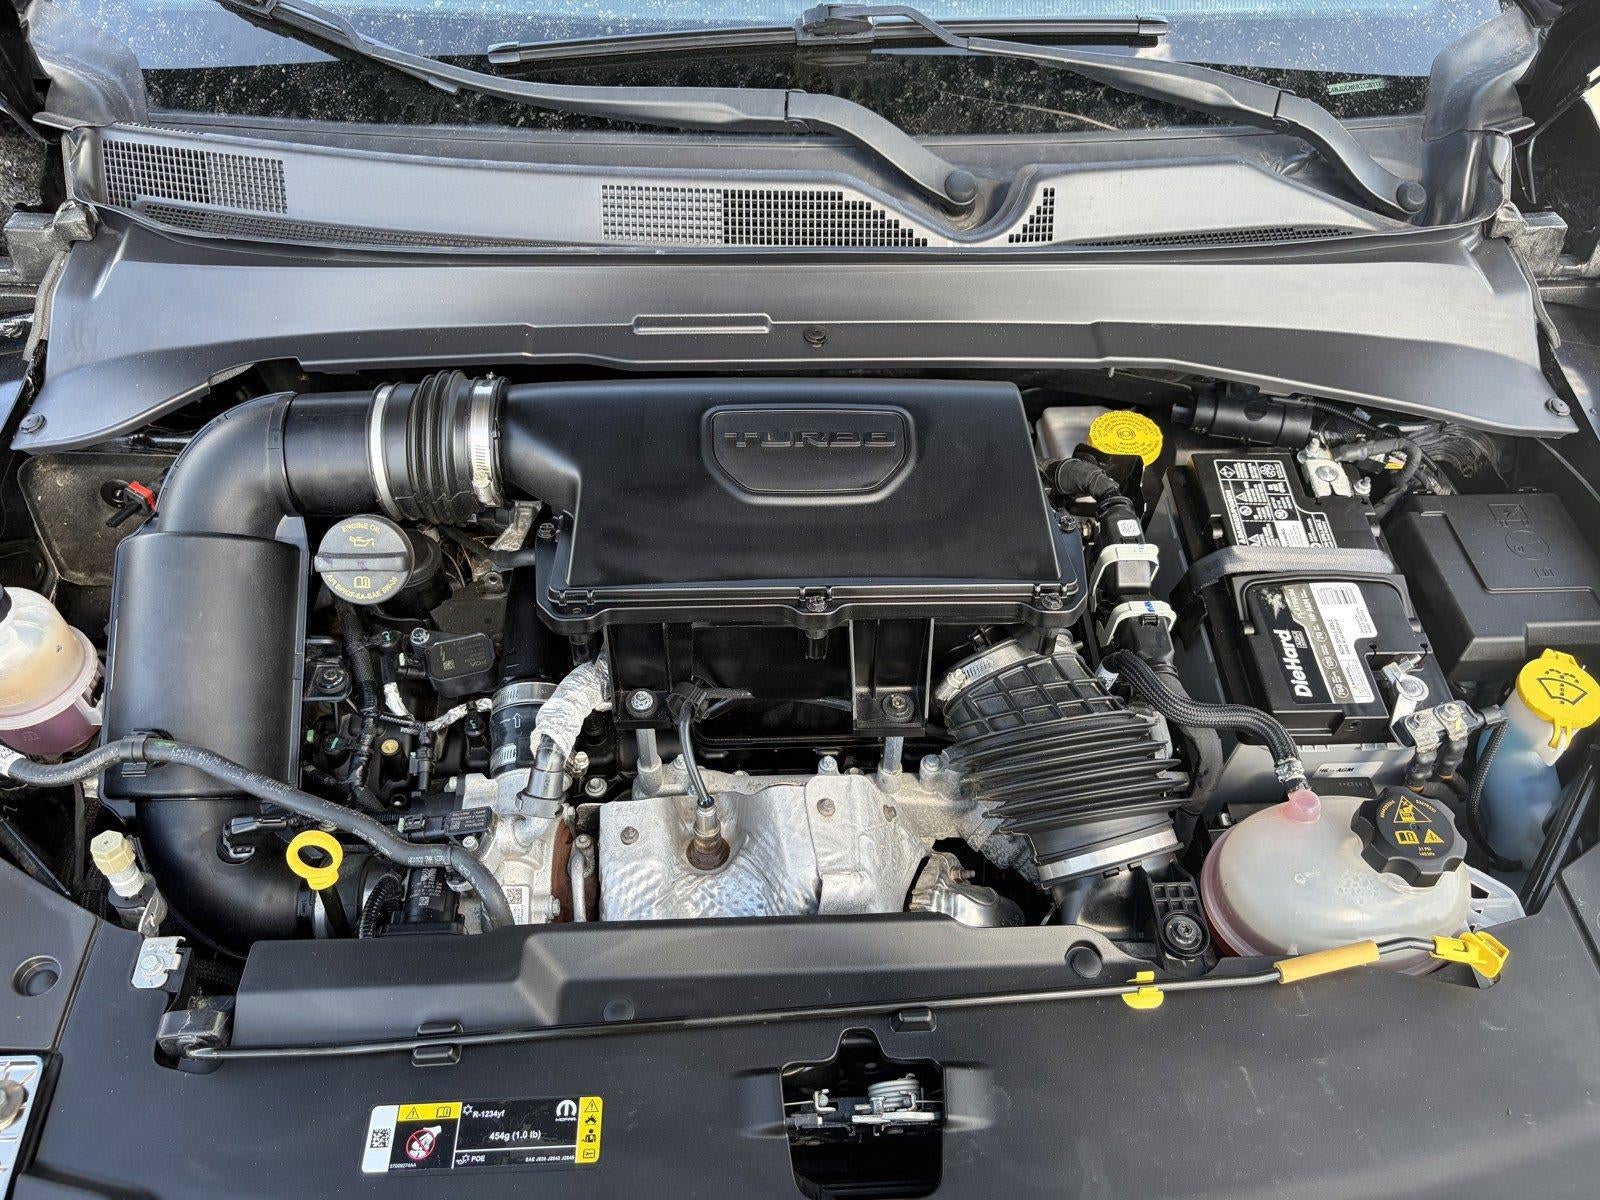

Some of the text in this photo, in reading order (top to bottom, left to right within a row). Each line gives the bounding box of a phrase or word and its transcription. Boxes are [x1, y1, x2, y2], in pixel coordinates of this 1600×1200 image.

[724, 431, 896, 448] TURBO
[342, 523, 381, 534] ENGINE OIL
[326, 574, 337, 586] API
[1273, 628, 1314, 698] DieHard
[473, 1109, 505, 1119] R-1234yf
[489, 1129, 541, 1141] 454g (1.0 lb)
[471, 1155, 486, 1163] POE
